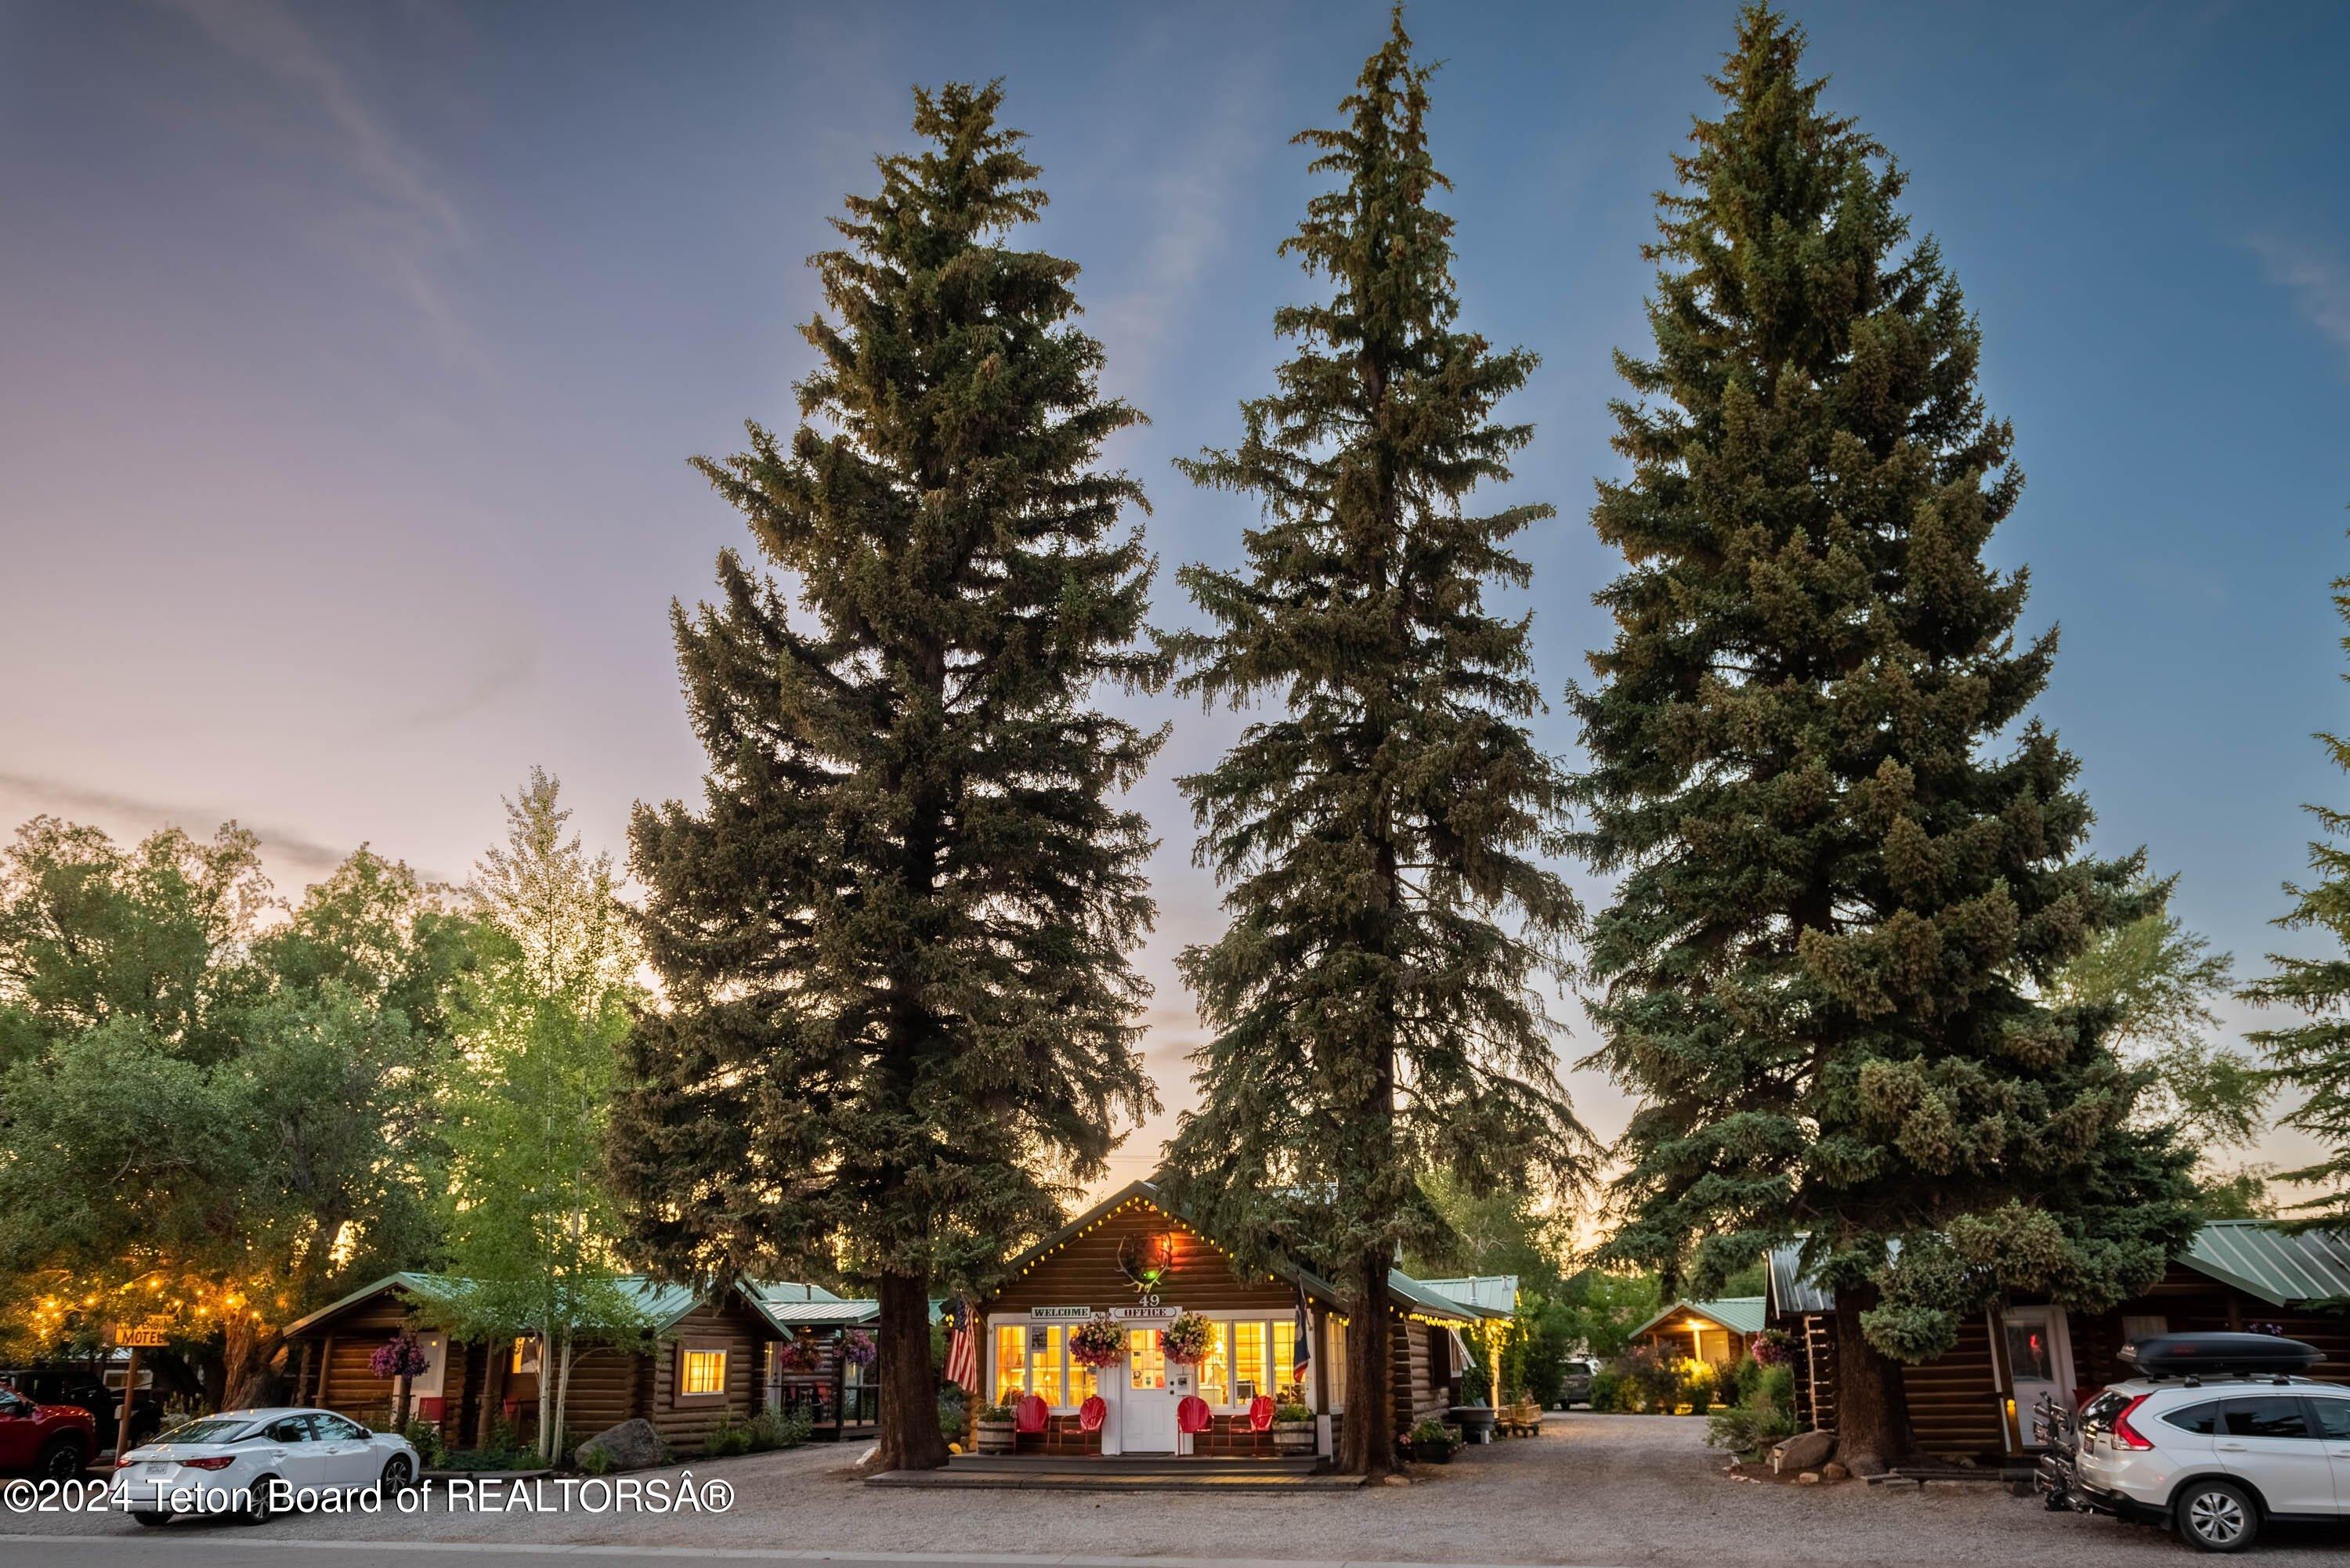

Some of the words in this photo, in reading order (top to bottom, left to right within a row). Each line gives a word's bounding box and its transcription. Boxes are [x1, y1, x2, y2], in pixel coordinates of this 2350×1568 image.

[1139, 1294, 1160, 1307] 49
[1124, 1308, 1166, 1317] OFFICE
[123, 1331, 163, 1344] MOTEL
